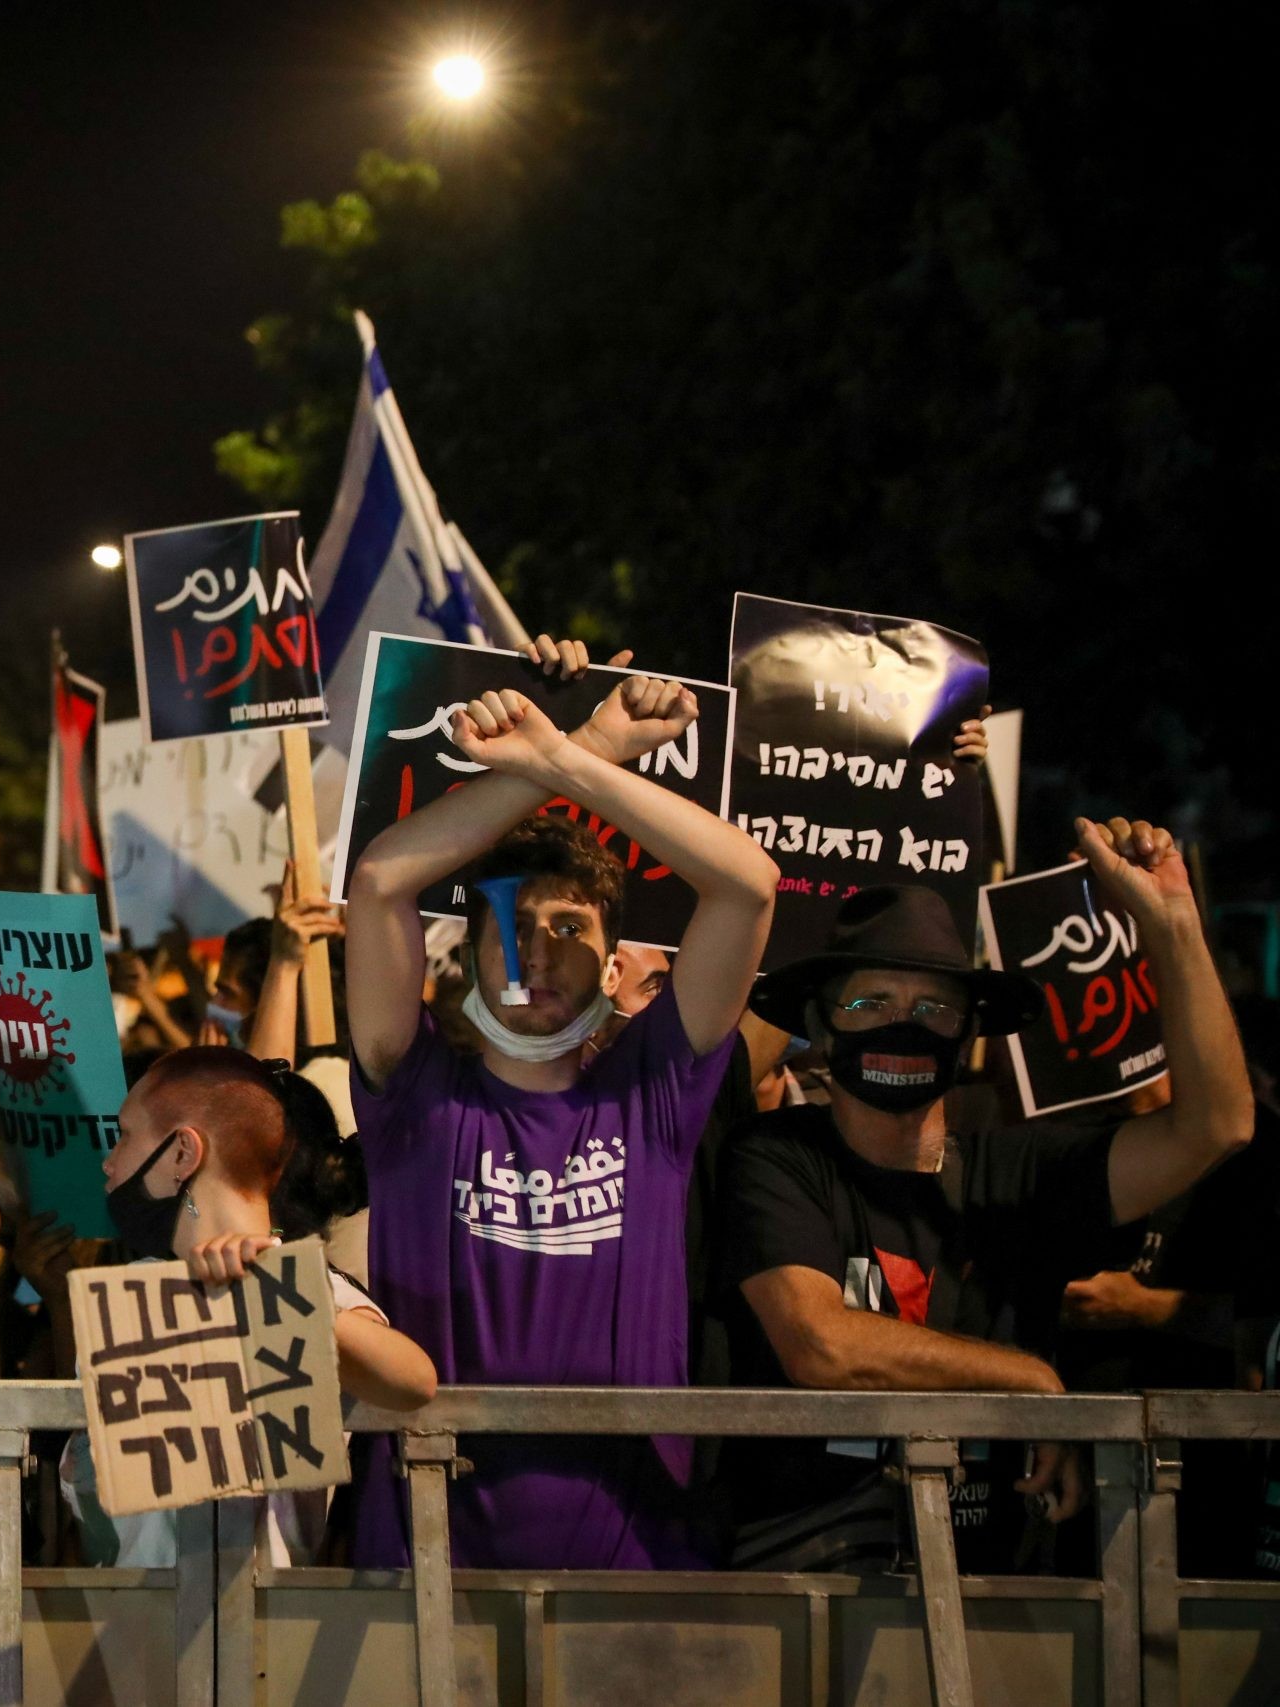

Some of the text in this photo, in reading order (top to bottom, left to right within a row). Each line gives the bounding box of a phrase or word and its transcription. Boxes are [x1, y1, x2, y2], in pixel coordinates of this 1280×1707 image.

[759, 743, 955, 799] יש מסיבה!
[898, 826, 969, 873] בוא
[861, 1068, 936, 1086] MINISTER
[120, 1405, 325, 1498] אוויר
[954, 1506, 988, 1528] יהיה
